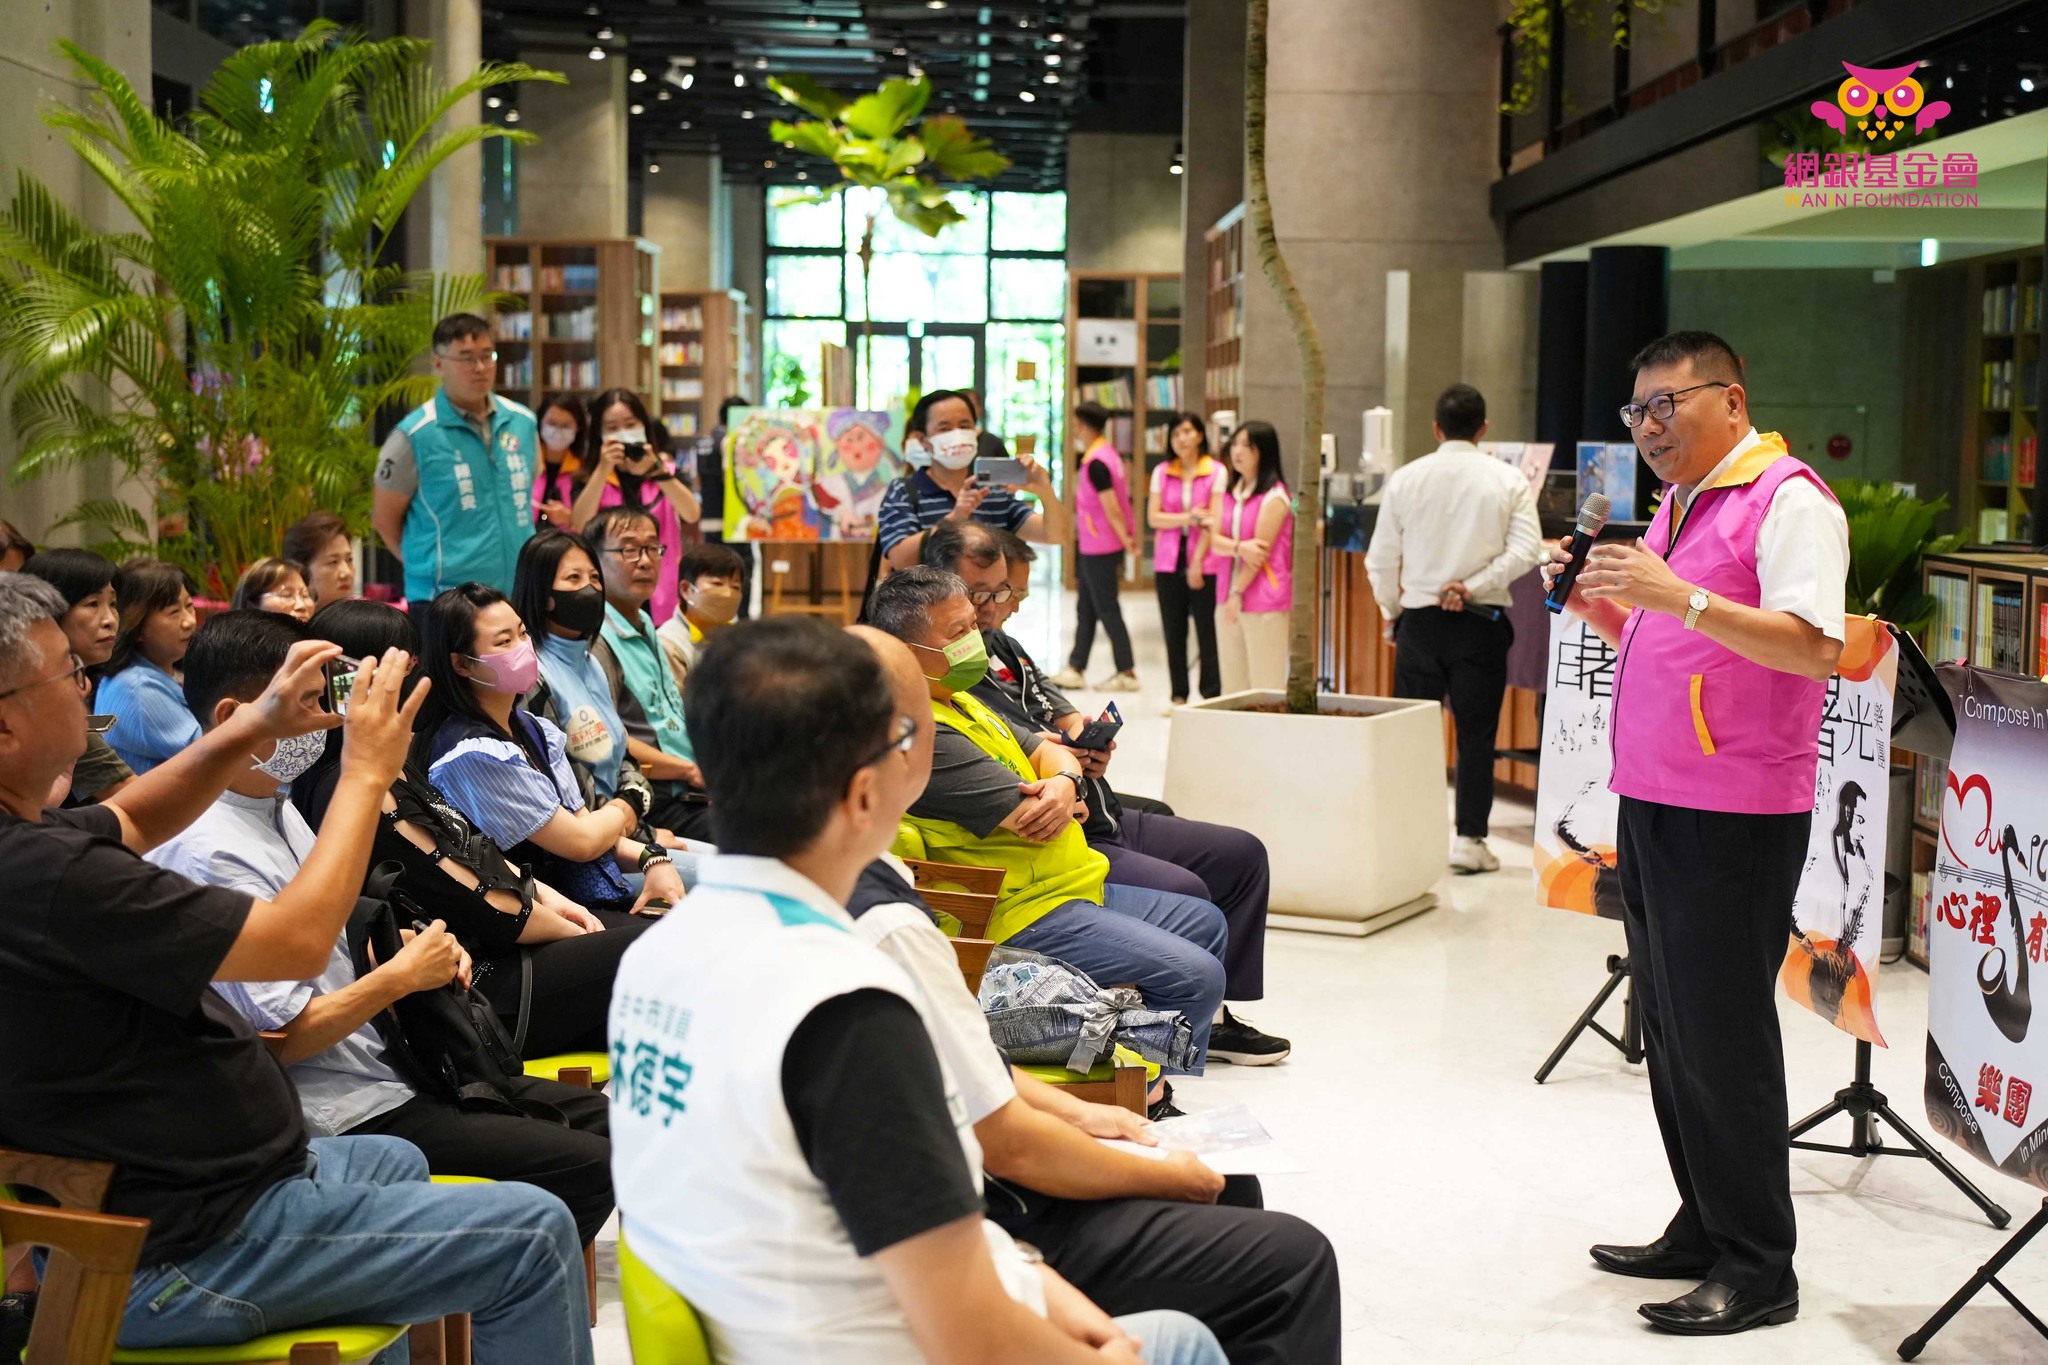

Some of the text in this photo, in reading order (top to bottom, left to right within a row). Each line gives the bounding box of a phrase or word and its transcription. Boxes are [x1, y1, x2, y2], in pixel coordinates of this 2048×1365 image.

[1964, 695, 2044, 730] Compose In
[1936, 891, 2048, 965] 心裡 有
[1937, 1062, 1978, 1135] Compose
[2029, 1126, 2048, 1153] Min
[1974, 1062, 2033, 1128] 樂團
